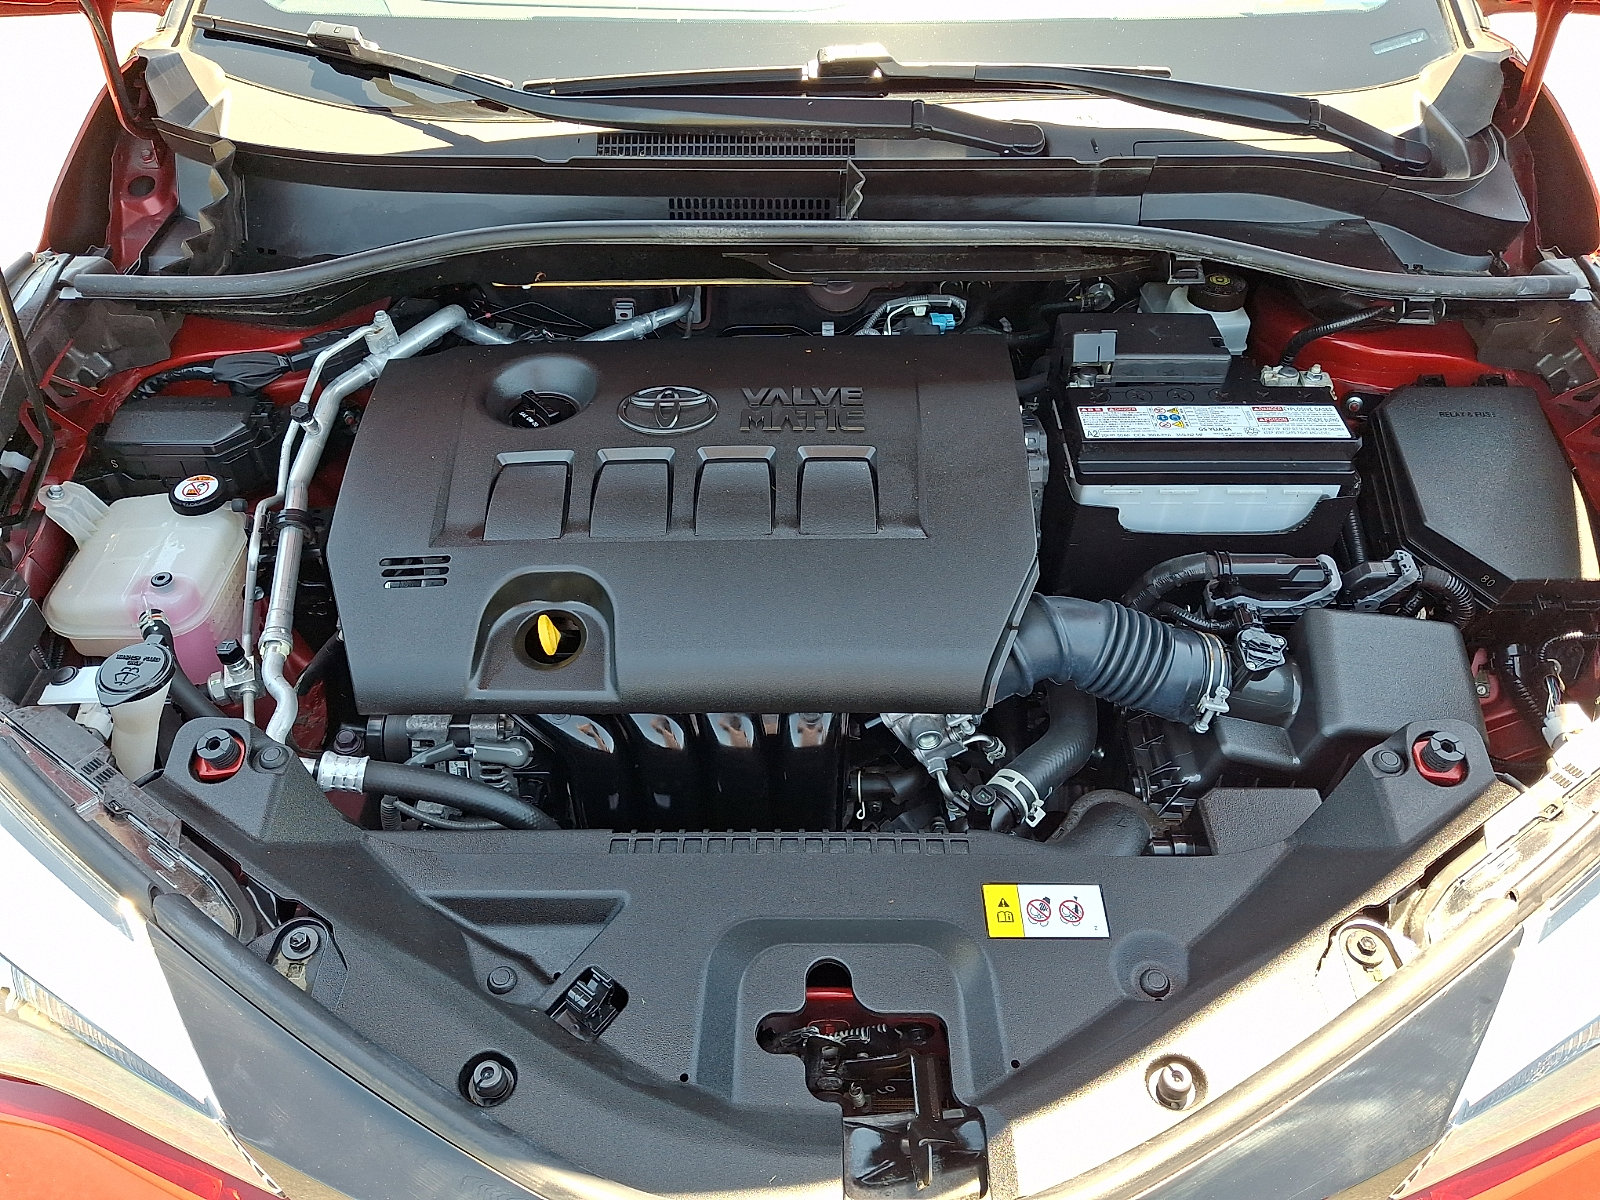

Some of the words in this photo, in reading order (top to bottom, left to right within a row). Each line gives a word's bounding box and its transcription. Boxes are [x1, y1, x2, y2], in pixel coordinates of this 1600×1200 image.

[741, 386, 864, 407] VALVE
[739, 407, 866, 432] MATIC
[1087, 430, 1099, 438] A2
[110, 459, 119, 468] S
[1481, 575, 1495, 586] 80
